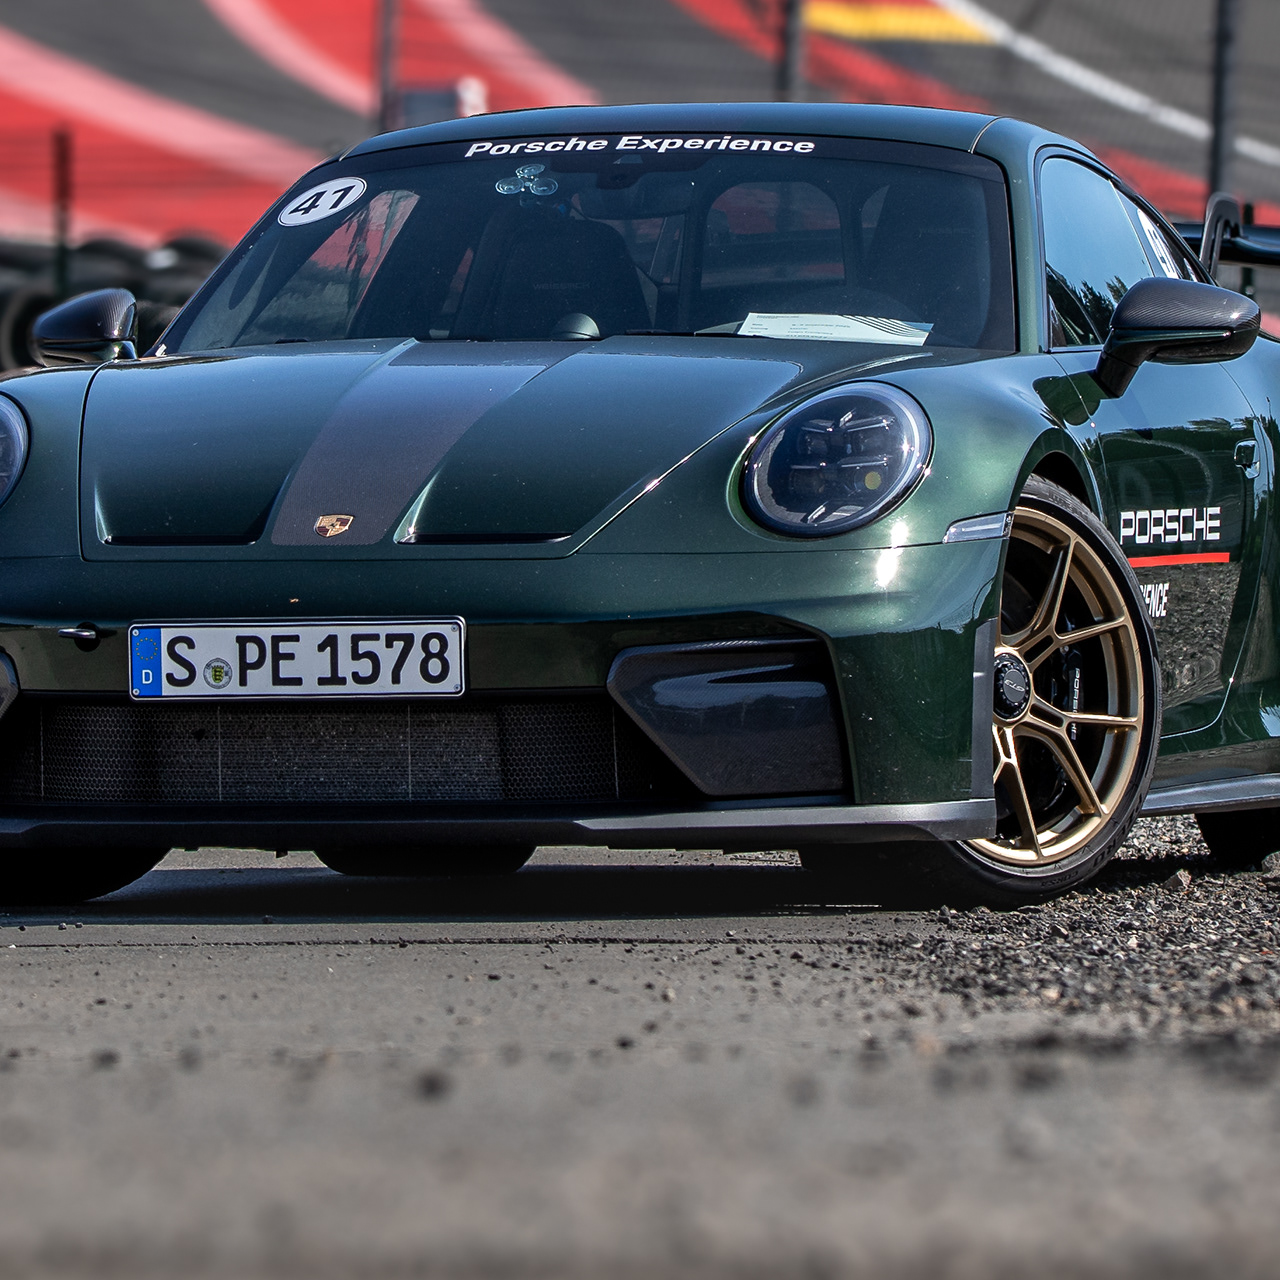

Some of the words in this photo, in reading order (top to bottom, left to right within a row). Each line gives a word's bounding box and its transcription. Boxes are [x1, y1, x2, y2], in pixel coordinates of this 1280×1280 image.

[465, 136, 608, 158] Porsche
[616, 135, 815, 154] Experience
[1120, 506, 1221, 545] PORSCHE
[165, 635, 197, 687] S
[235, 634, 303, 687] PE
[317, 632, 450, 686] 1578
[141, 669, 153, 684] D
